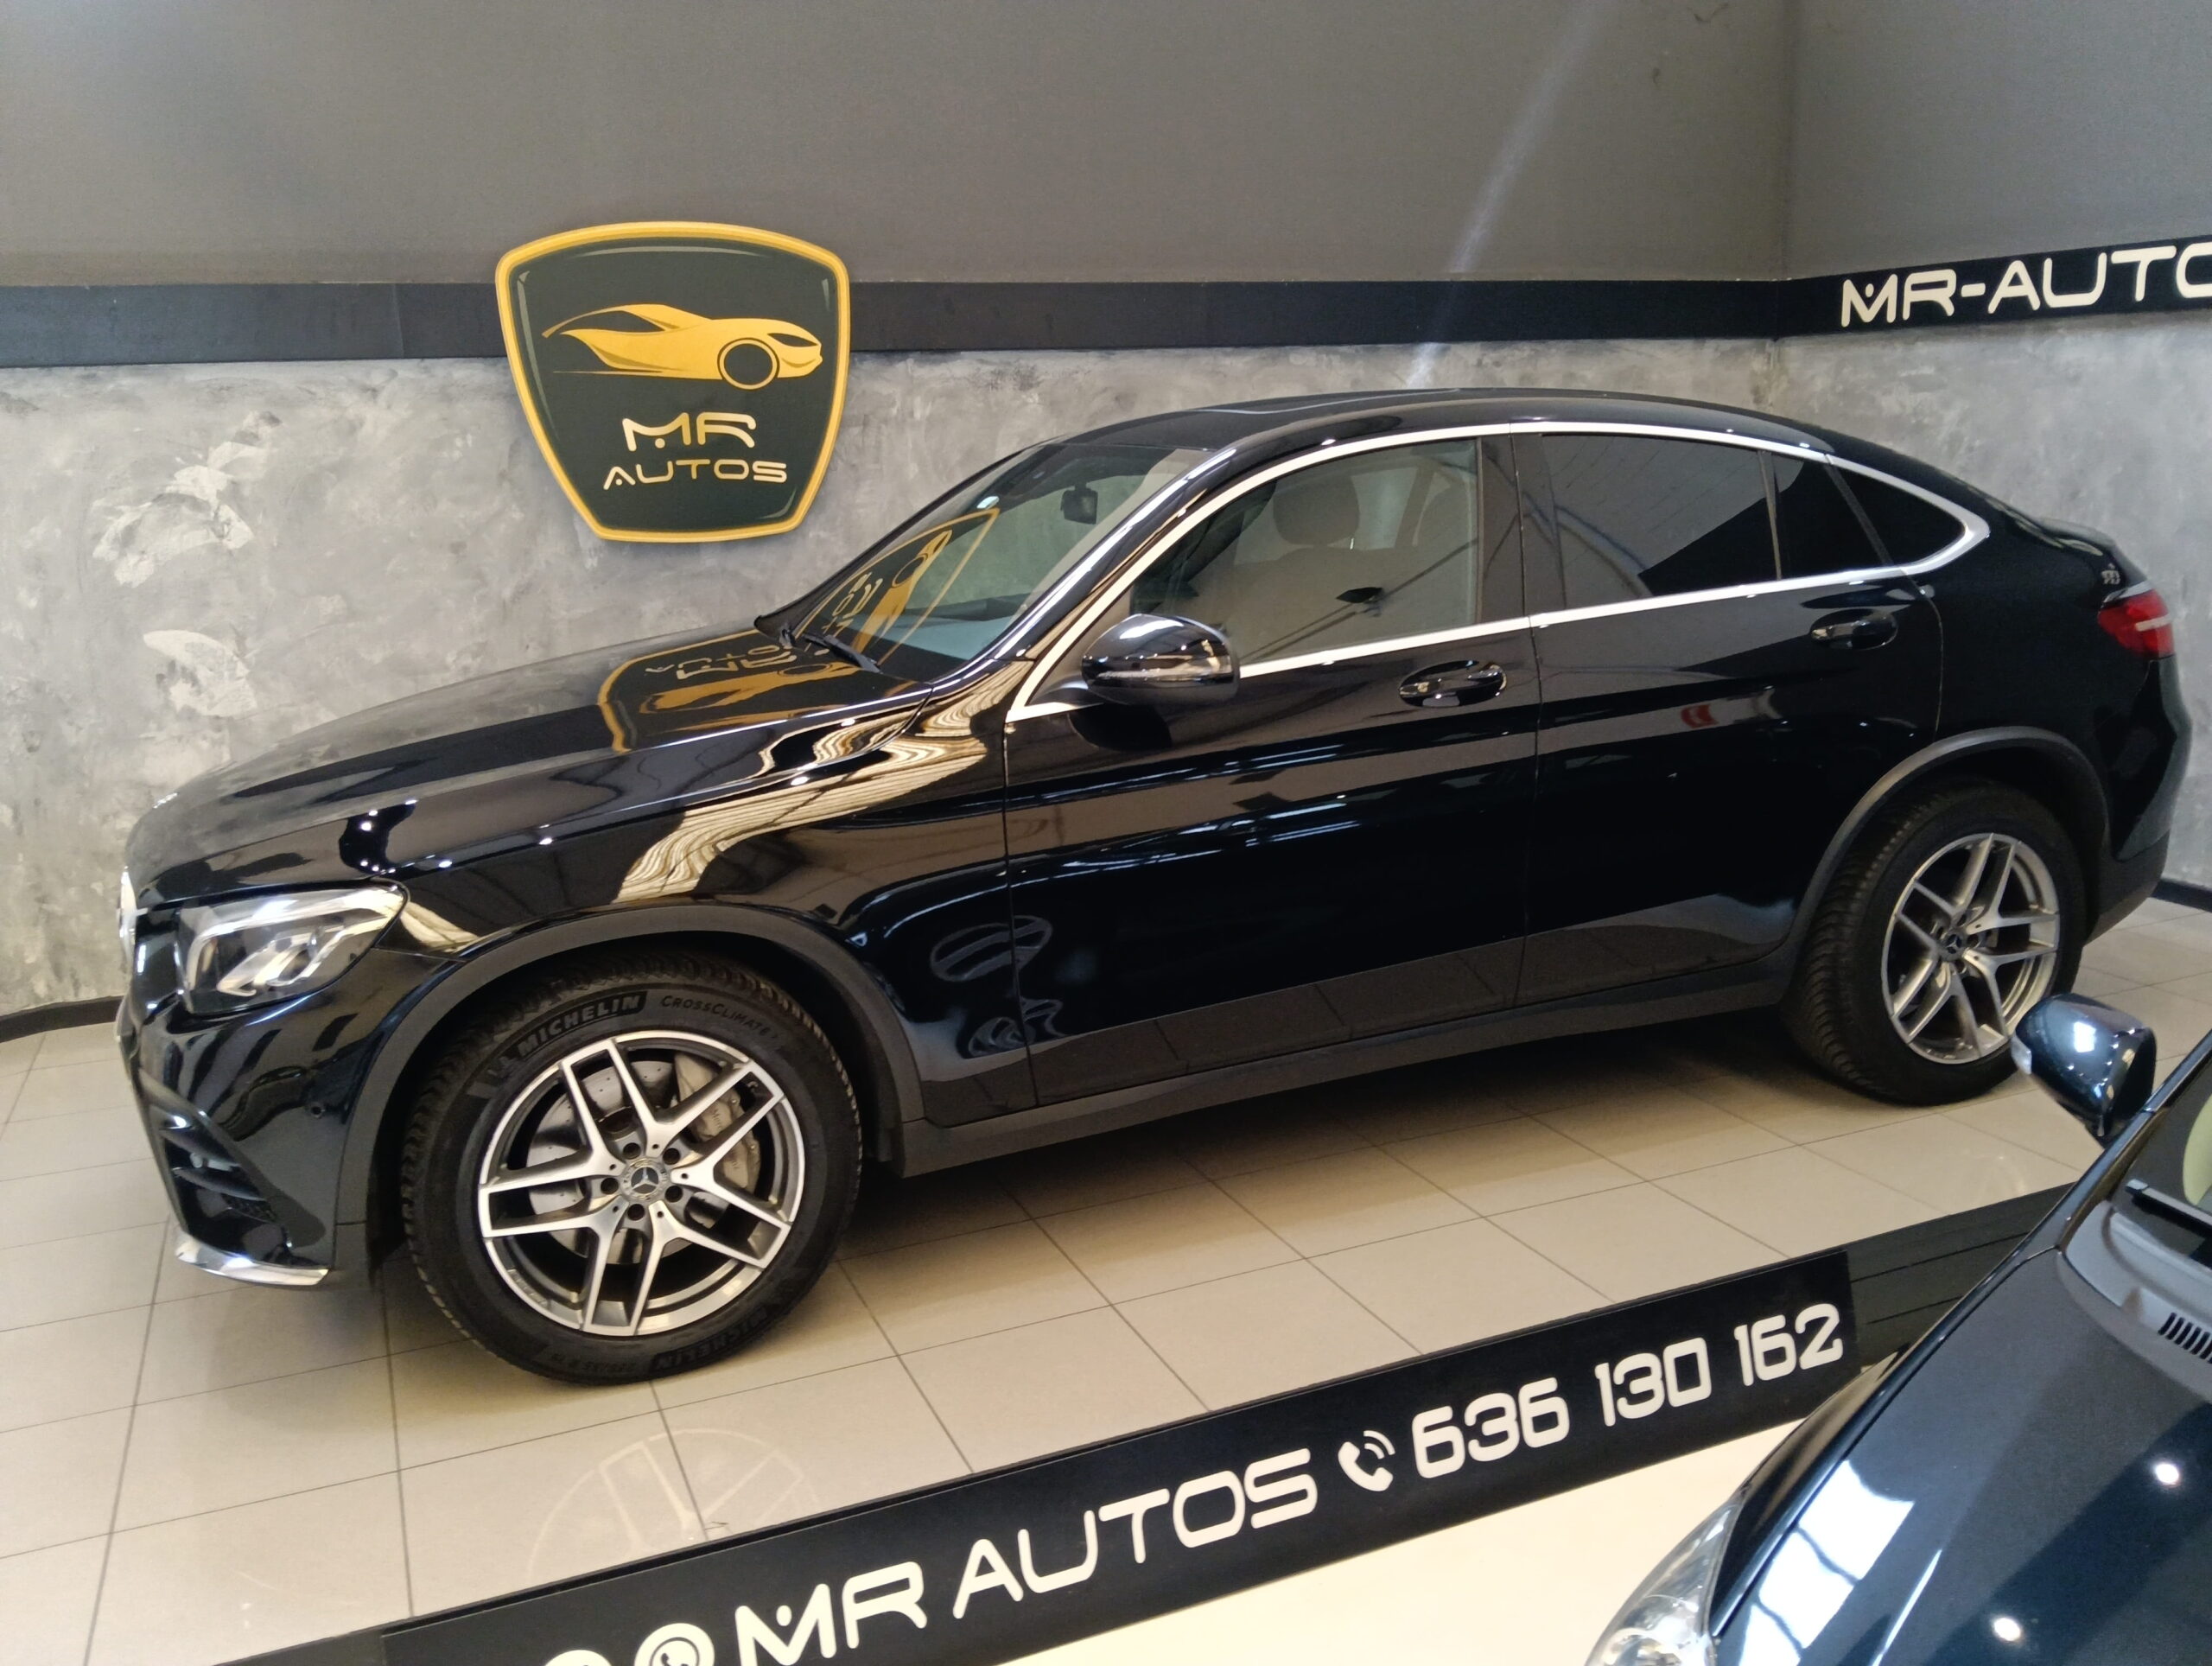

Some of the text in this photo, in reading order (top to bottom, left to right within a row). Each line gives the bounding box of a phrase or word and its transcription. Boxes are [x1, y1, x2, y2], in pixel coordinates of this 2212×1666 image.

[621, 411, 757, 452] MR
[603, 458, 787, 490] AUTOS
[518, 995, 641, 1059] MICHELIN
[734, 1303, 1845, 1666] MR AUTOS 636 130 162
